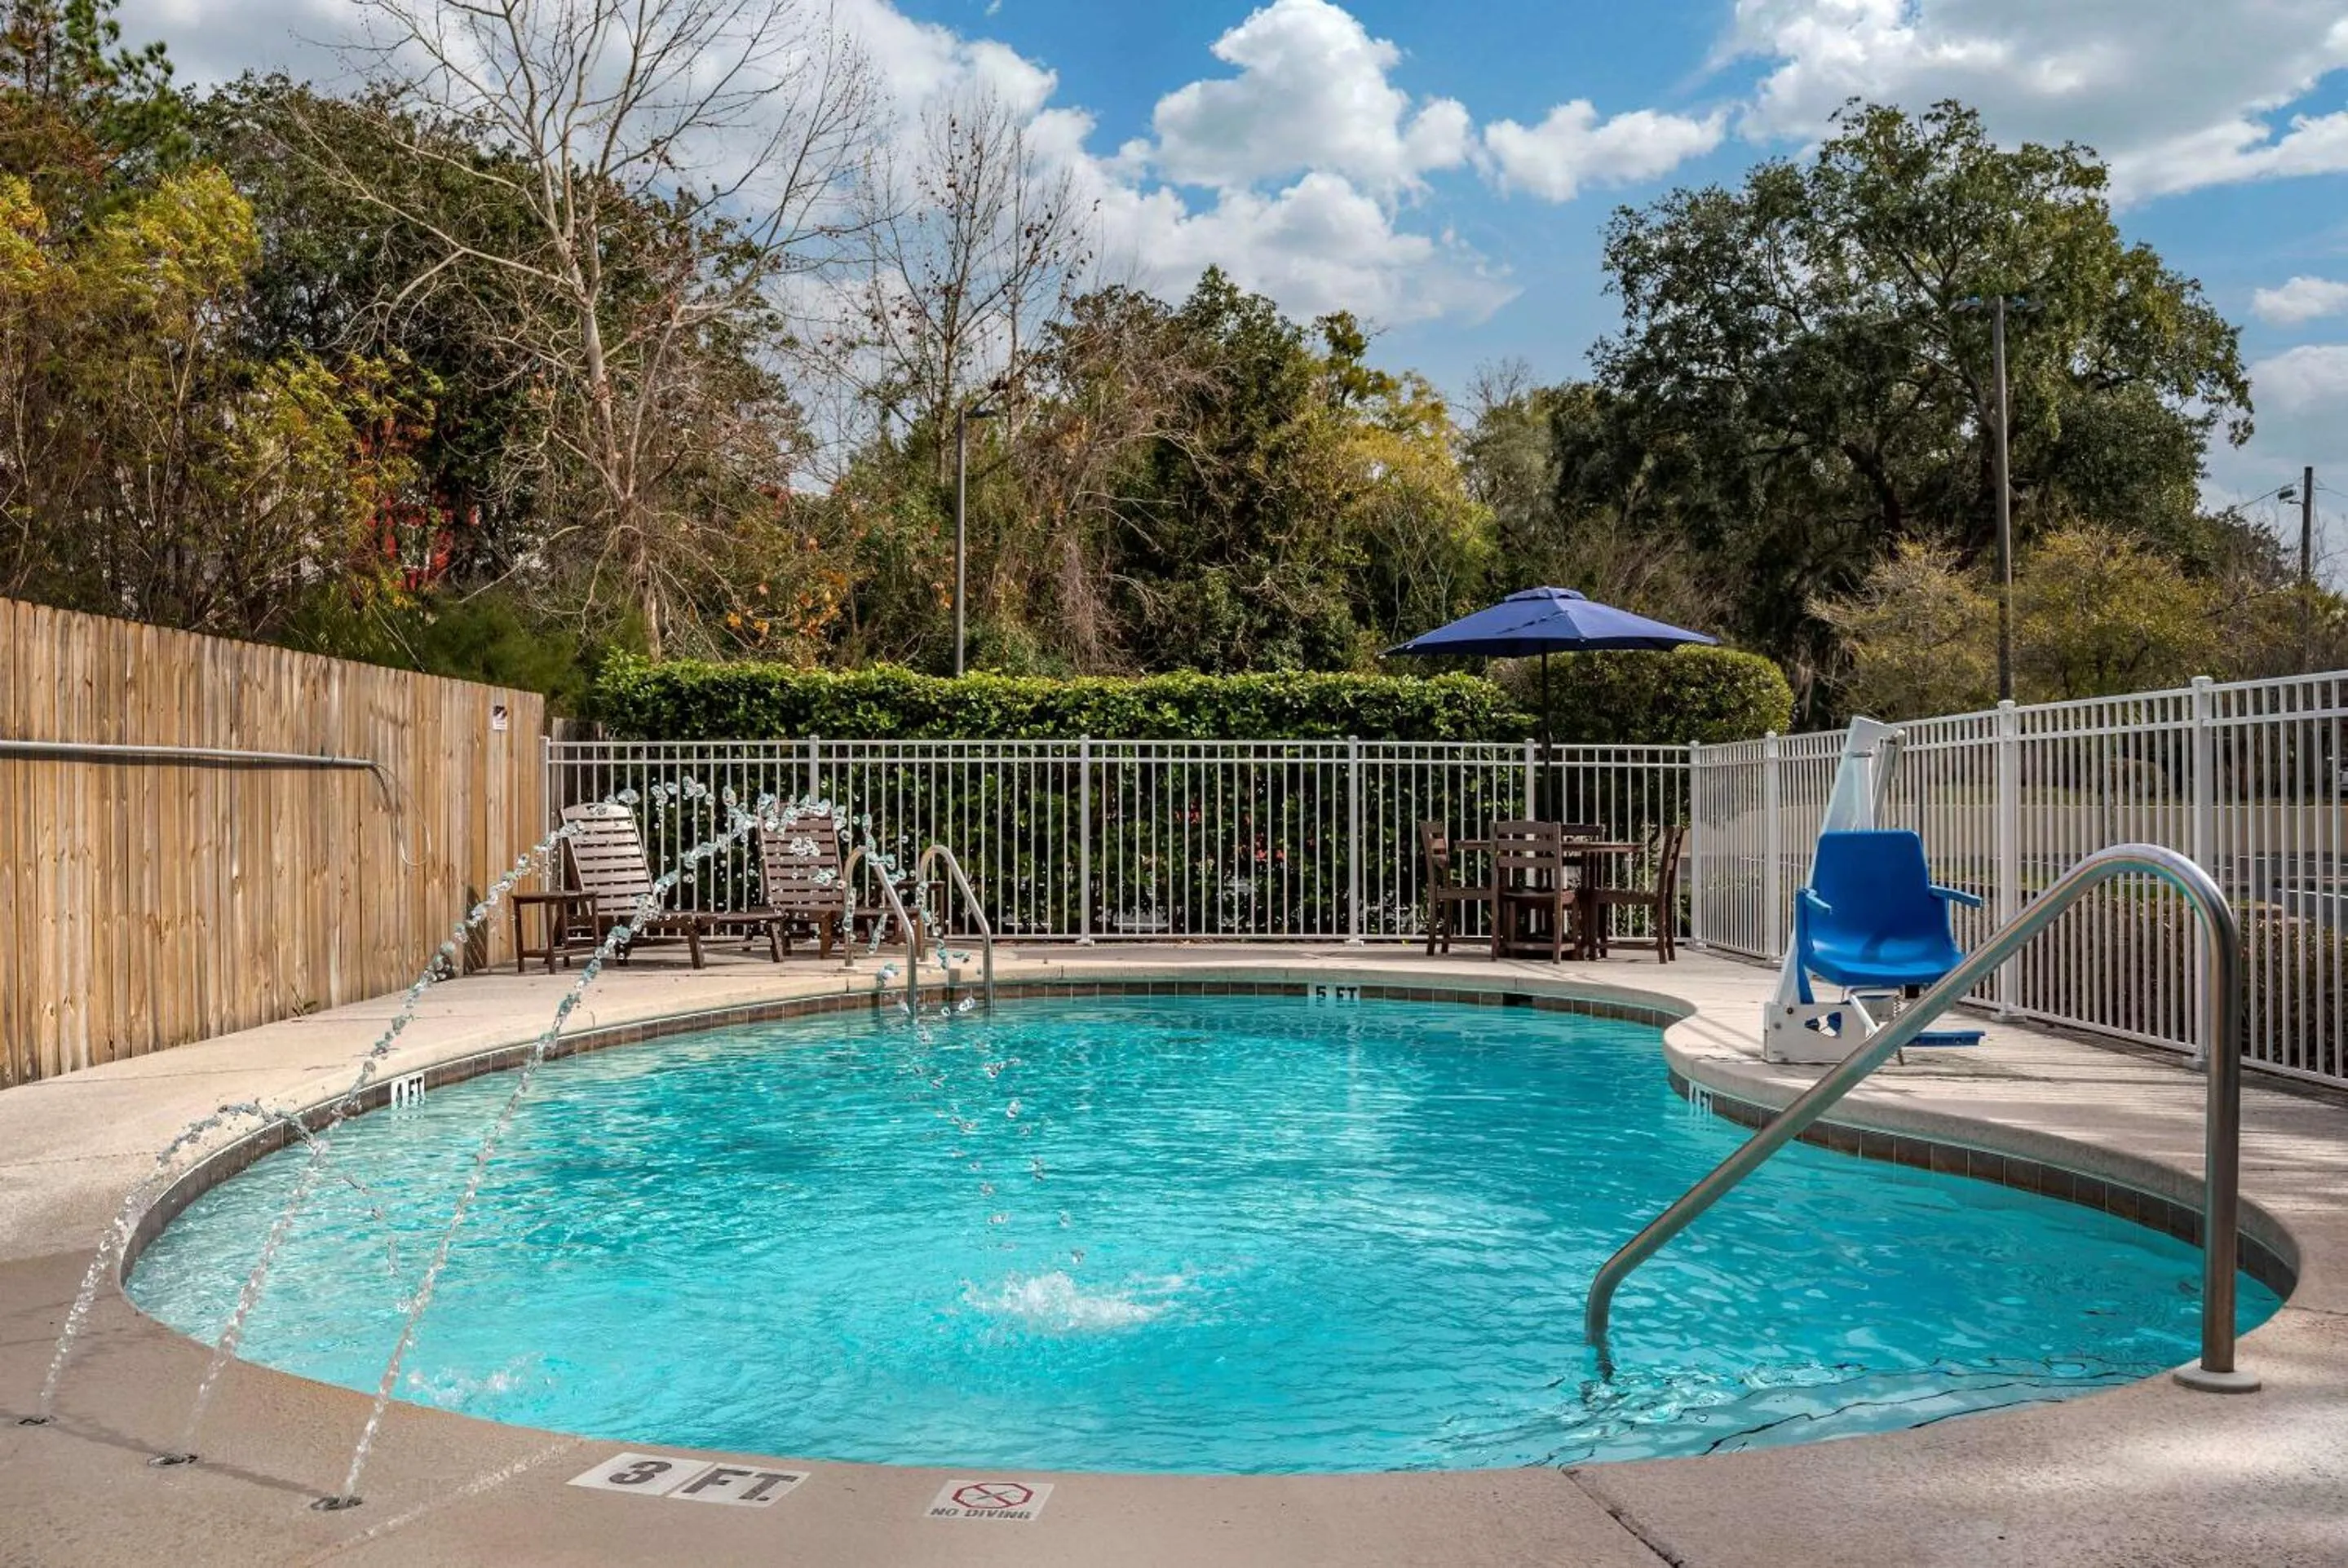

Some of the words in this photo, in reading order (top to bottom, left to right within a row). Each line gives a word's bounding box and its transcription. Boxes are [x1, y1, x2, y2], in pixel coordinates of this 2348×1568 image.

[1315, 985, 1327, 999] 5
[1336, 987, 1358, 1001] FT
[409, 1076, 422, 1102] FT
[608, 1461, 673, 1485] 3
[682, 1468, 799, 1501] FT.
[931, 1508, 958, 1517] NO
[964, 1508, 1033, 1519] DIVING
